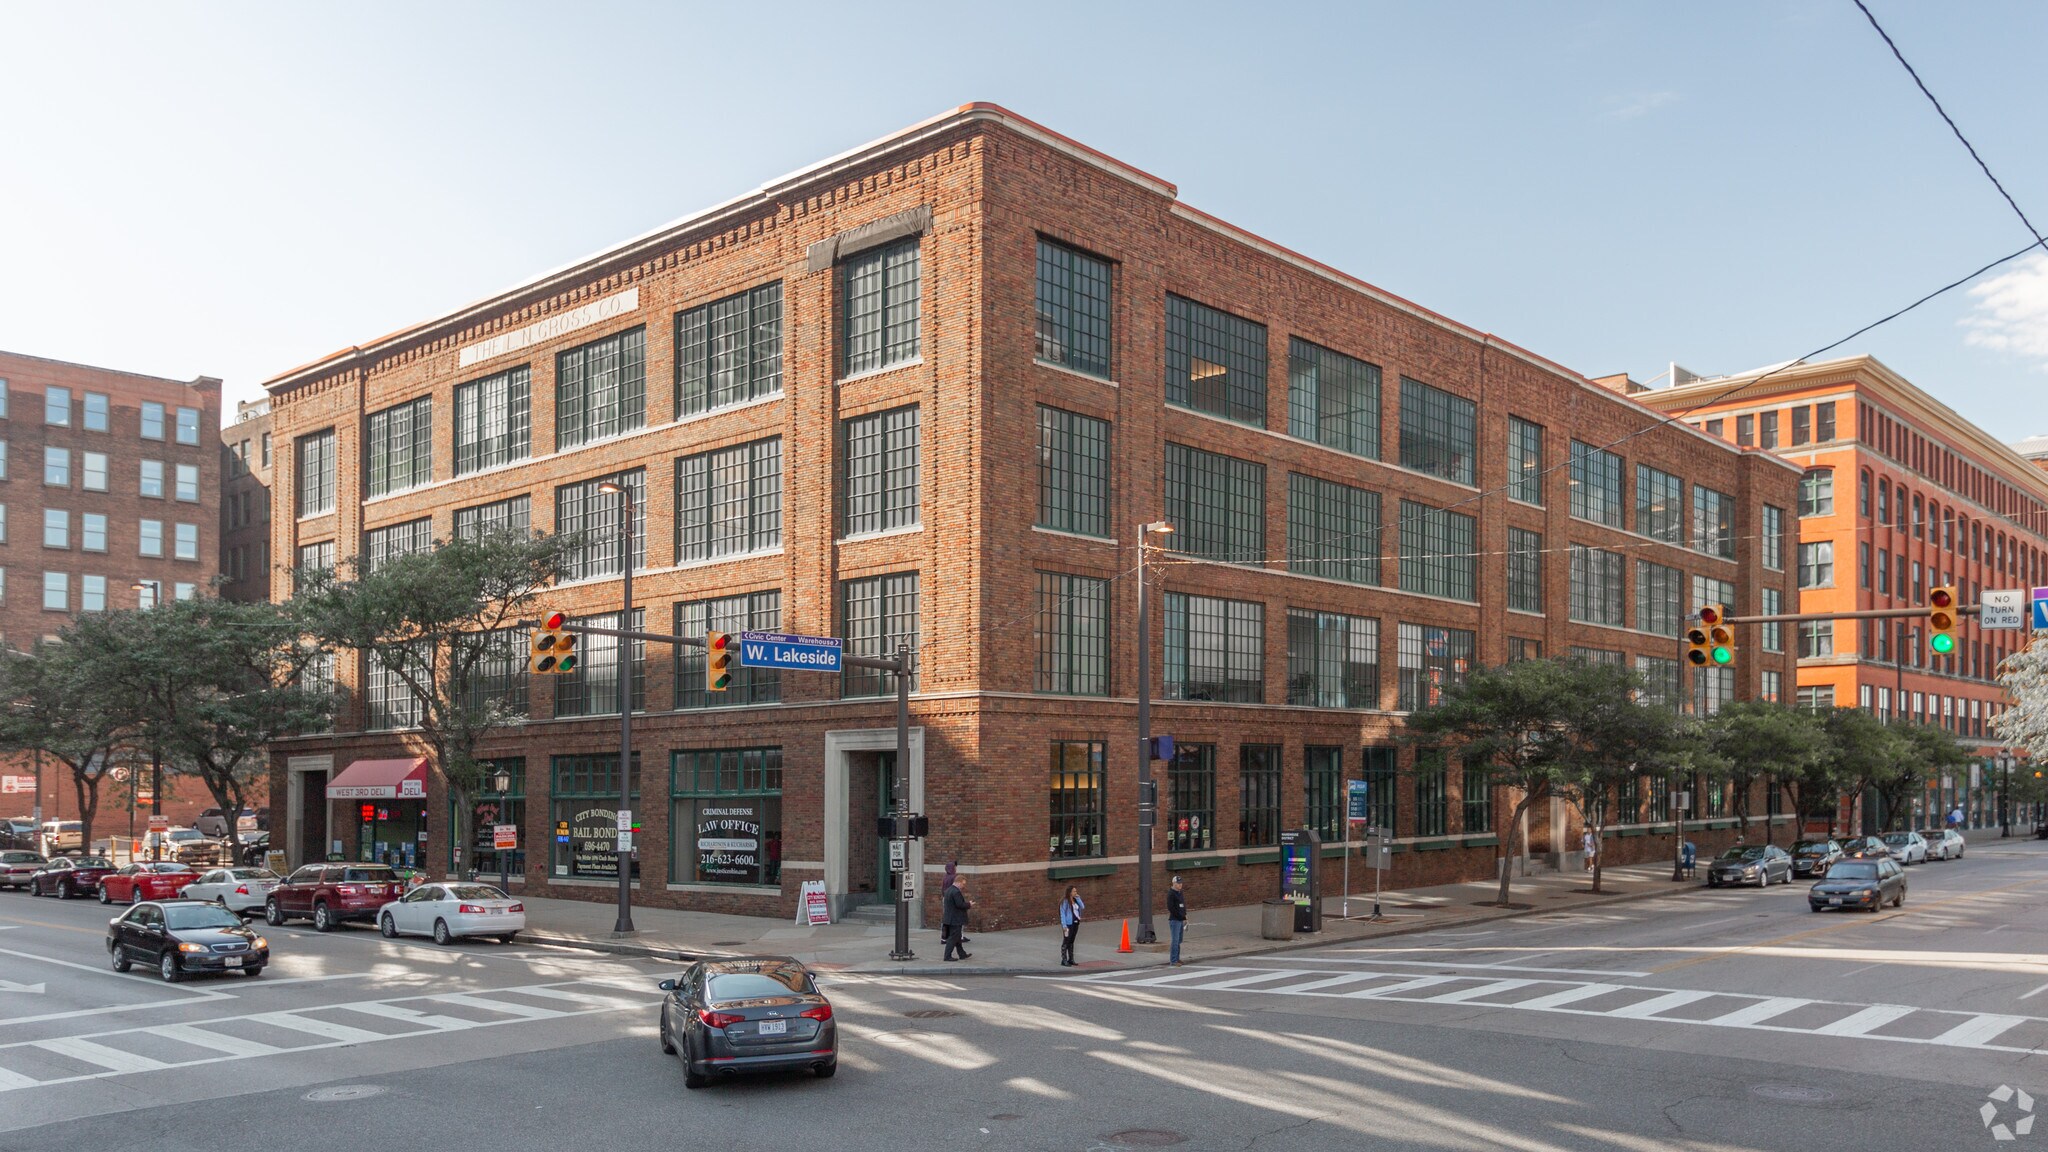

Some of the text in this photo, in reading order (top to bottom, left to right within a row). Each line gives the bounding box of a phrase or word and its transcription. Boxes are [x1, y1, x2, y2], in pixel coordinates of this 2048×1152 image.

[474, 341, 502, 360] THE
[538, 307, 592, 338] GROSS
[599, 297, 624, 317] CO.
[1994, 595, 2010, 603] NO
[1990, 606, 2014, 614] TURN
[1984, 616, 2019, 624] ON RED
[749, 632, 834, 646] Civic Center Warehouse
[746, 644, 836, 665] W. Lakeside
[336, 788, 386, 797] WEST 3RD DELI
[403, 787, 421, 796] DELI
[575, 810, 590, 823] CITY
[702, 808, 753, 816] CRIMINAL DEFENSE
[698, 819, 759, 835] LAW OFFICE
[572, 827, 593, 838] BAIL
[593, 827, 618, 839] BOND
[584, 841, 611, 851] 696-4470
[701, 854, 754, 865] 216-623-6600
